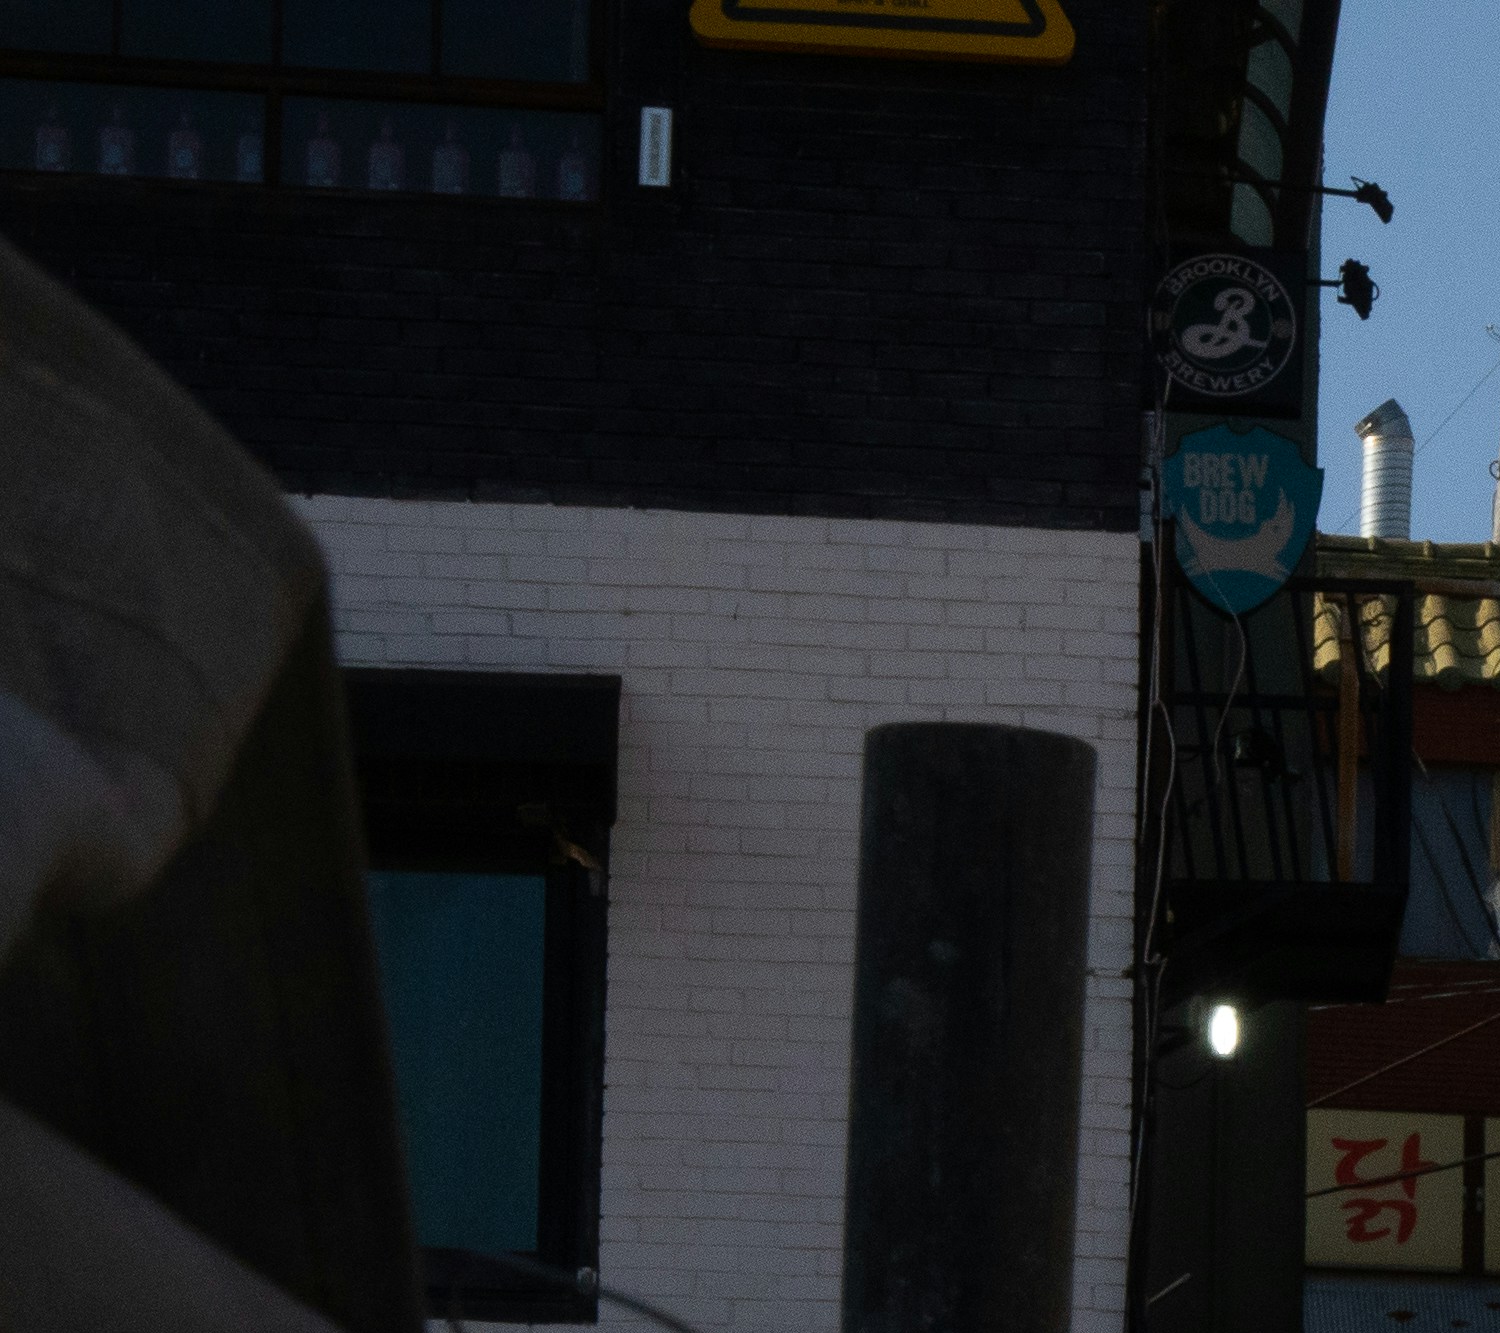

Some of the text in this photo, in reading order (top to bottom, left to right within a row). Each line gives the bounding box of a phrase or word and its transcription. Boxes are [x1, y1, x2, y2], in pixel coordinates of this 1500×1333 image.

[1167, 257, 1280, 302] BROOKLYN
[1160, 354, 1276, 392] BREWERY
[1182, 452, 1270, 490] BREW
[1201, 490, 1256, 525] DOG
